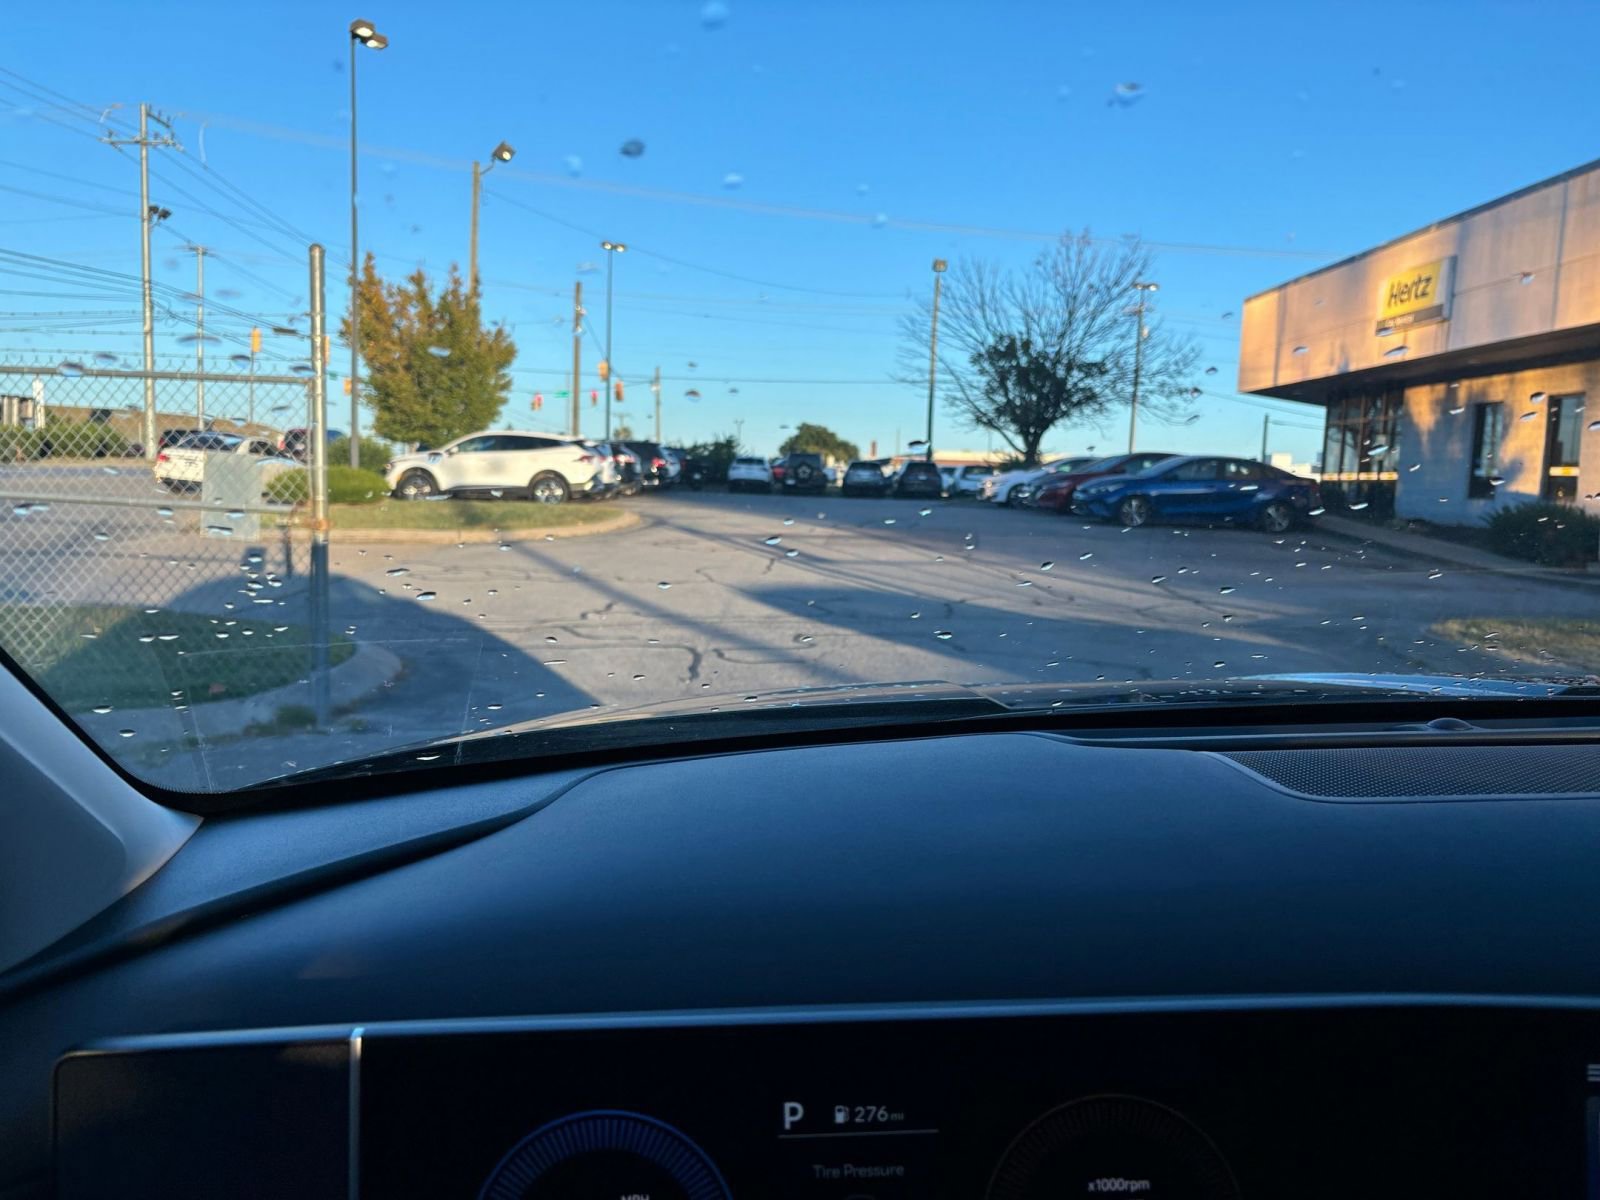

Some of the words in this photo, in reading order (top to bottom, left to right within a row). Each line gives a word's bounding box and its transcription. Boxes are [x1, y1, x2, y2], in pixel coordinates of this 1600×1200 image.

[1387, 273, 1433, 309] Hertz
[783, 1101, 804, 1130] P
[854, 1105, 889, 1123] 276
[812, 1164, 841, 1179] Tire
[843, 1163, 905, 1178] Pressure
[1087, 1177, 1151, 1192] x1000rpm
